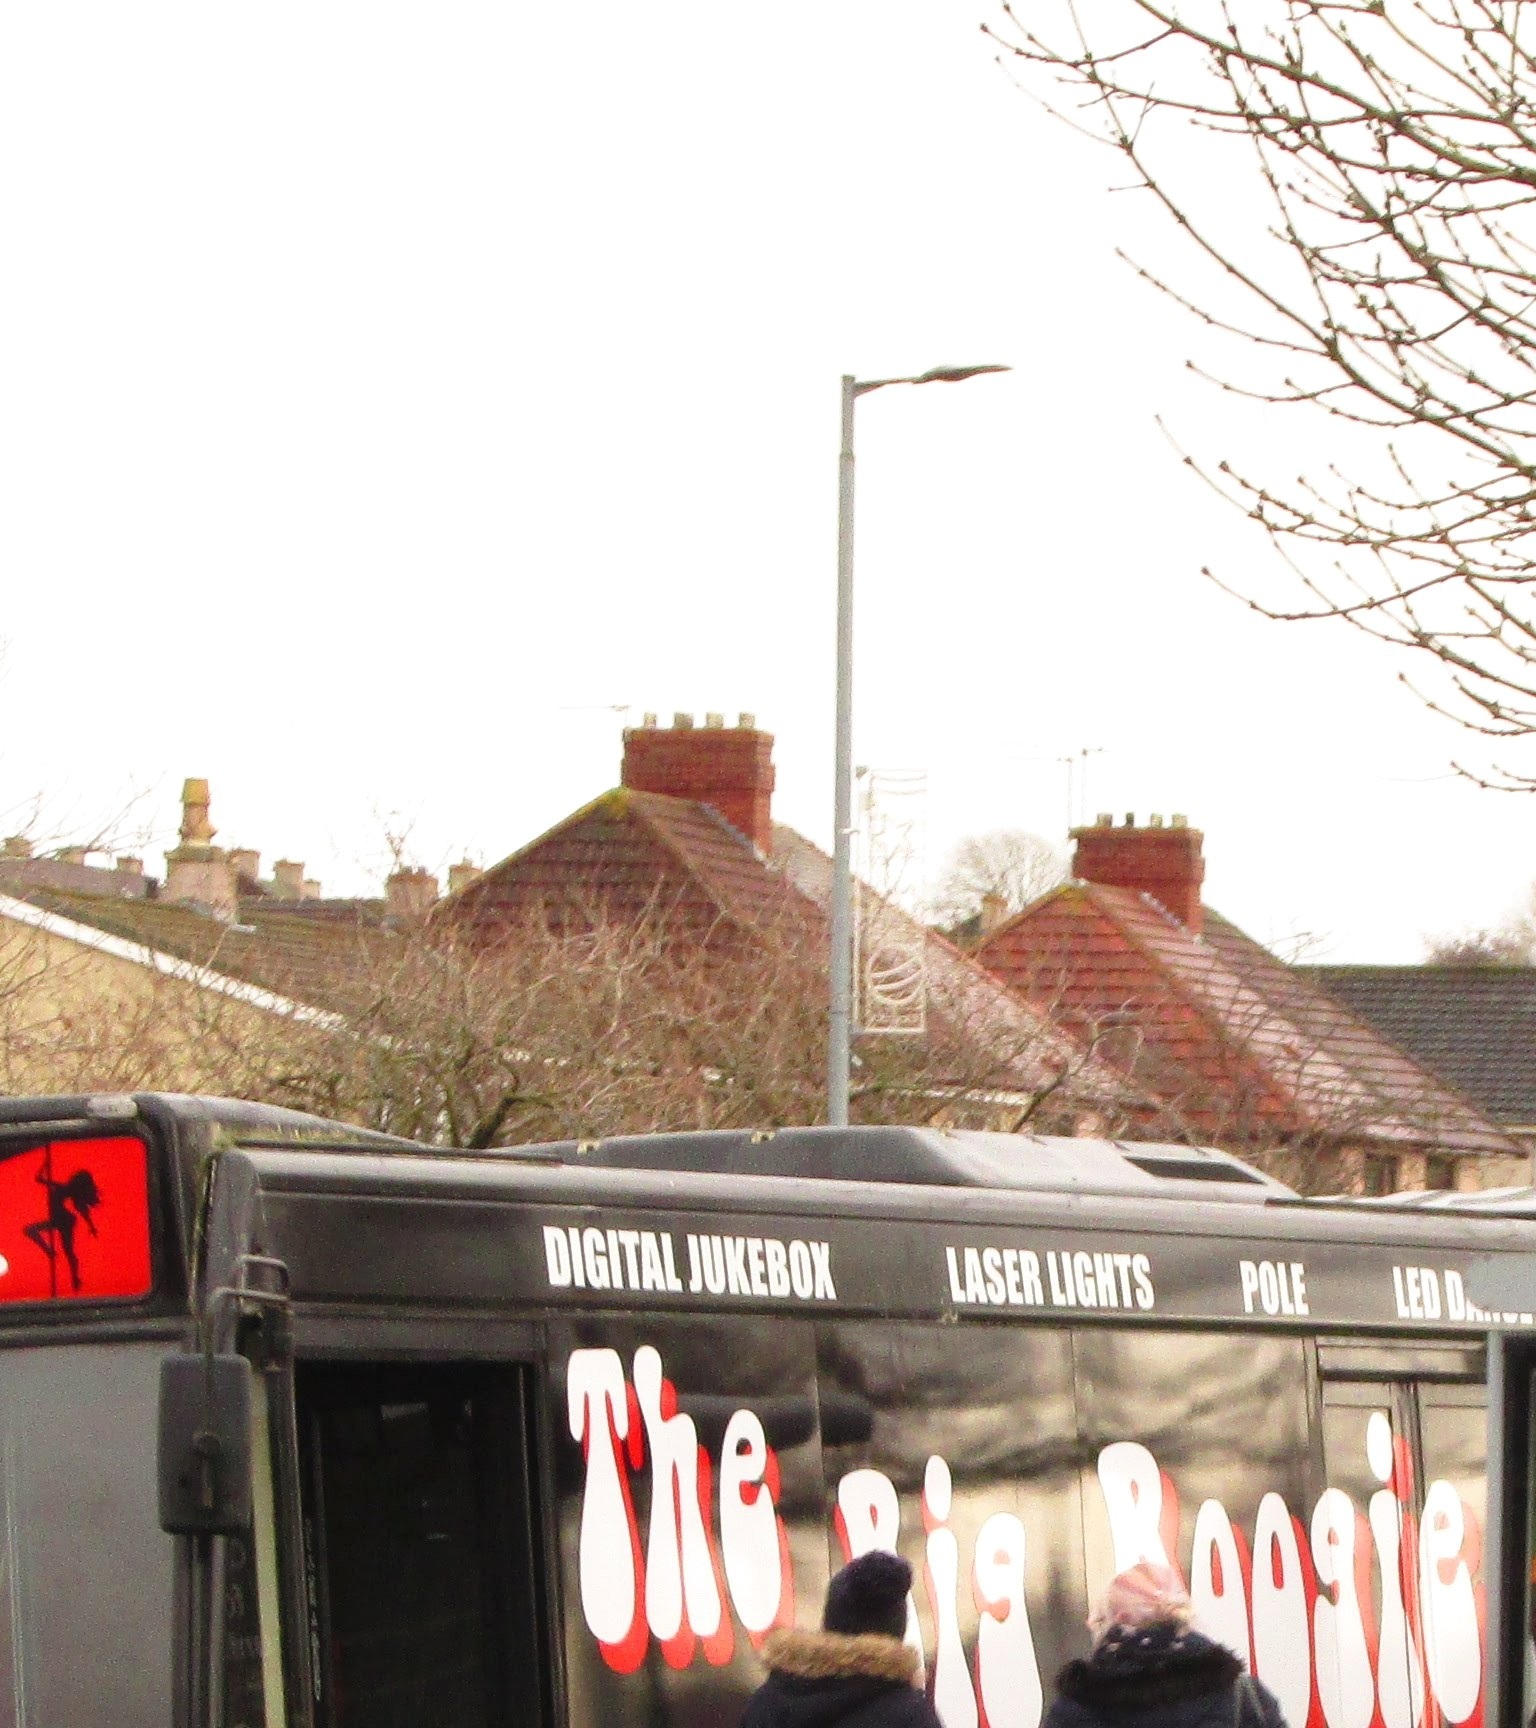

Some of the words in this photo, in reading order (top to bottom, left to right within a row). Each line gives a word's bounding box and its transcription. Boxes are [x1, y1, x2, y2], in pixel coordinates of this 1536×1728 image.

[542, 1225, 683, 1292] DIGITAL
[686, 1233, 838, 1301] JUKEBOX
[945, 1246, 1045, 1306] LASER
[1046, 1250, 1155, 1311] LIGHTS
[1239, 1260, 1310, 1315] POLE
[1393, 1266, 1440, 1319] LED
[567, 1345, 786, 1650] The
